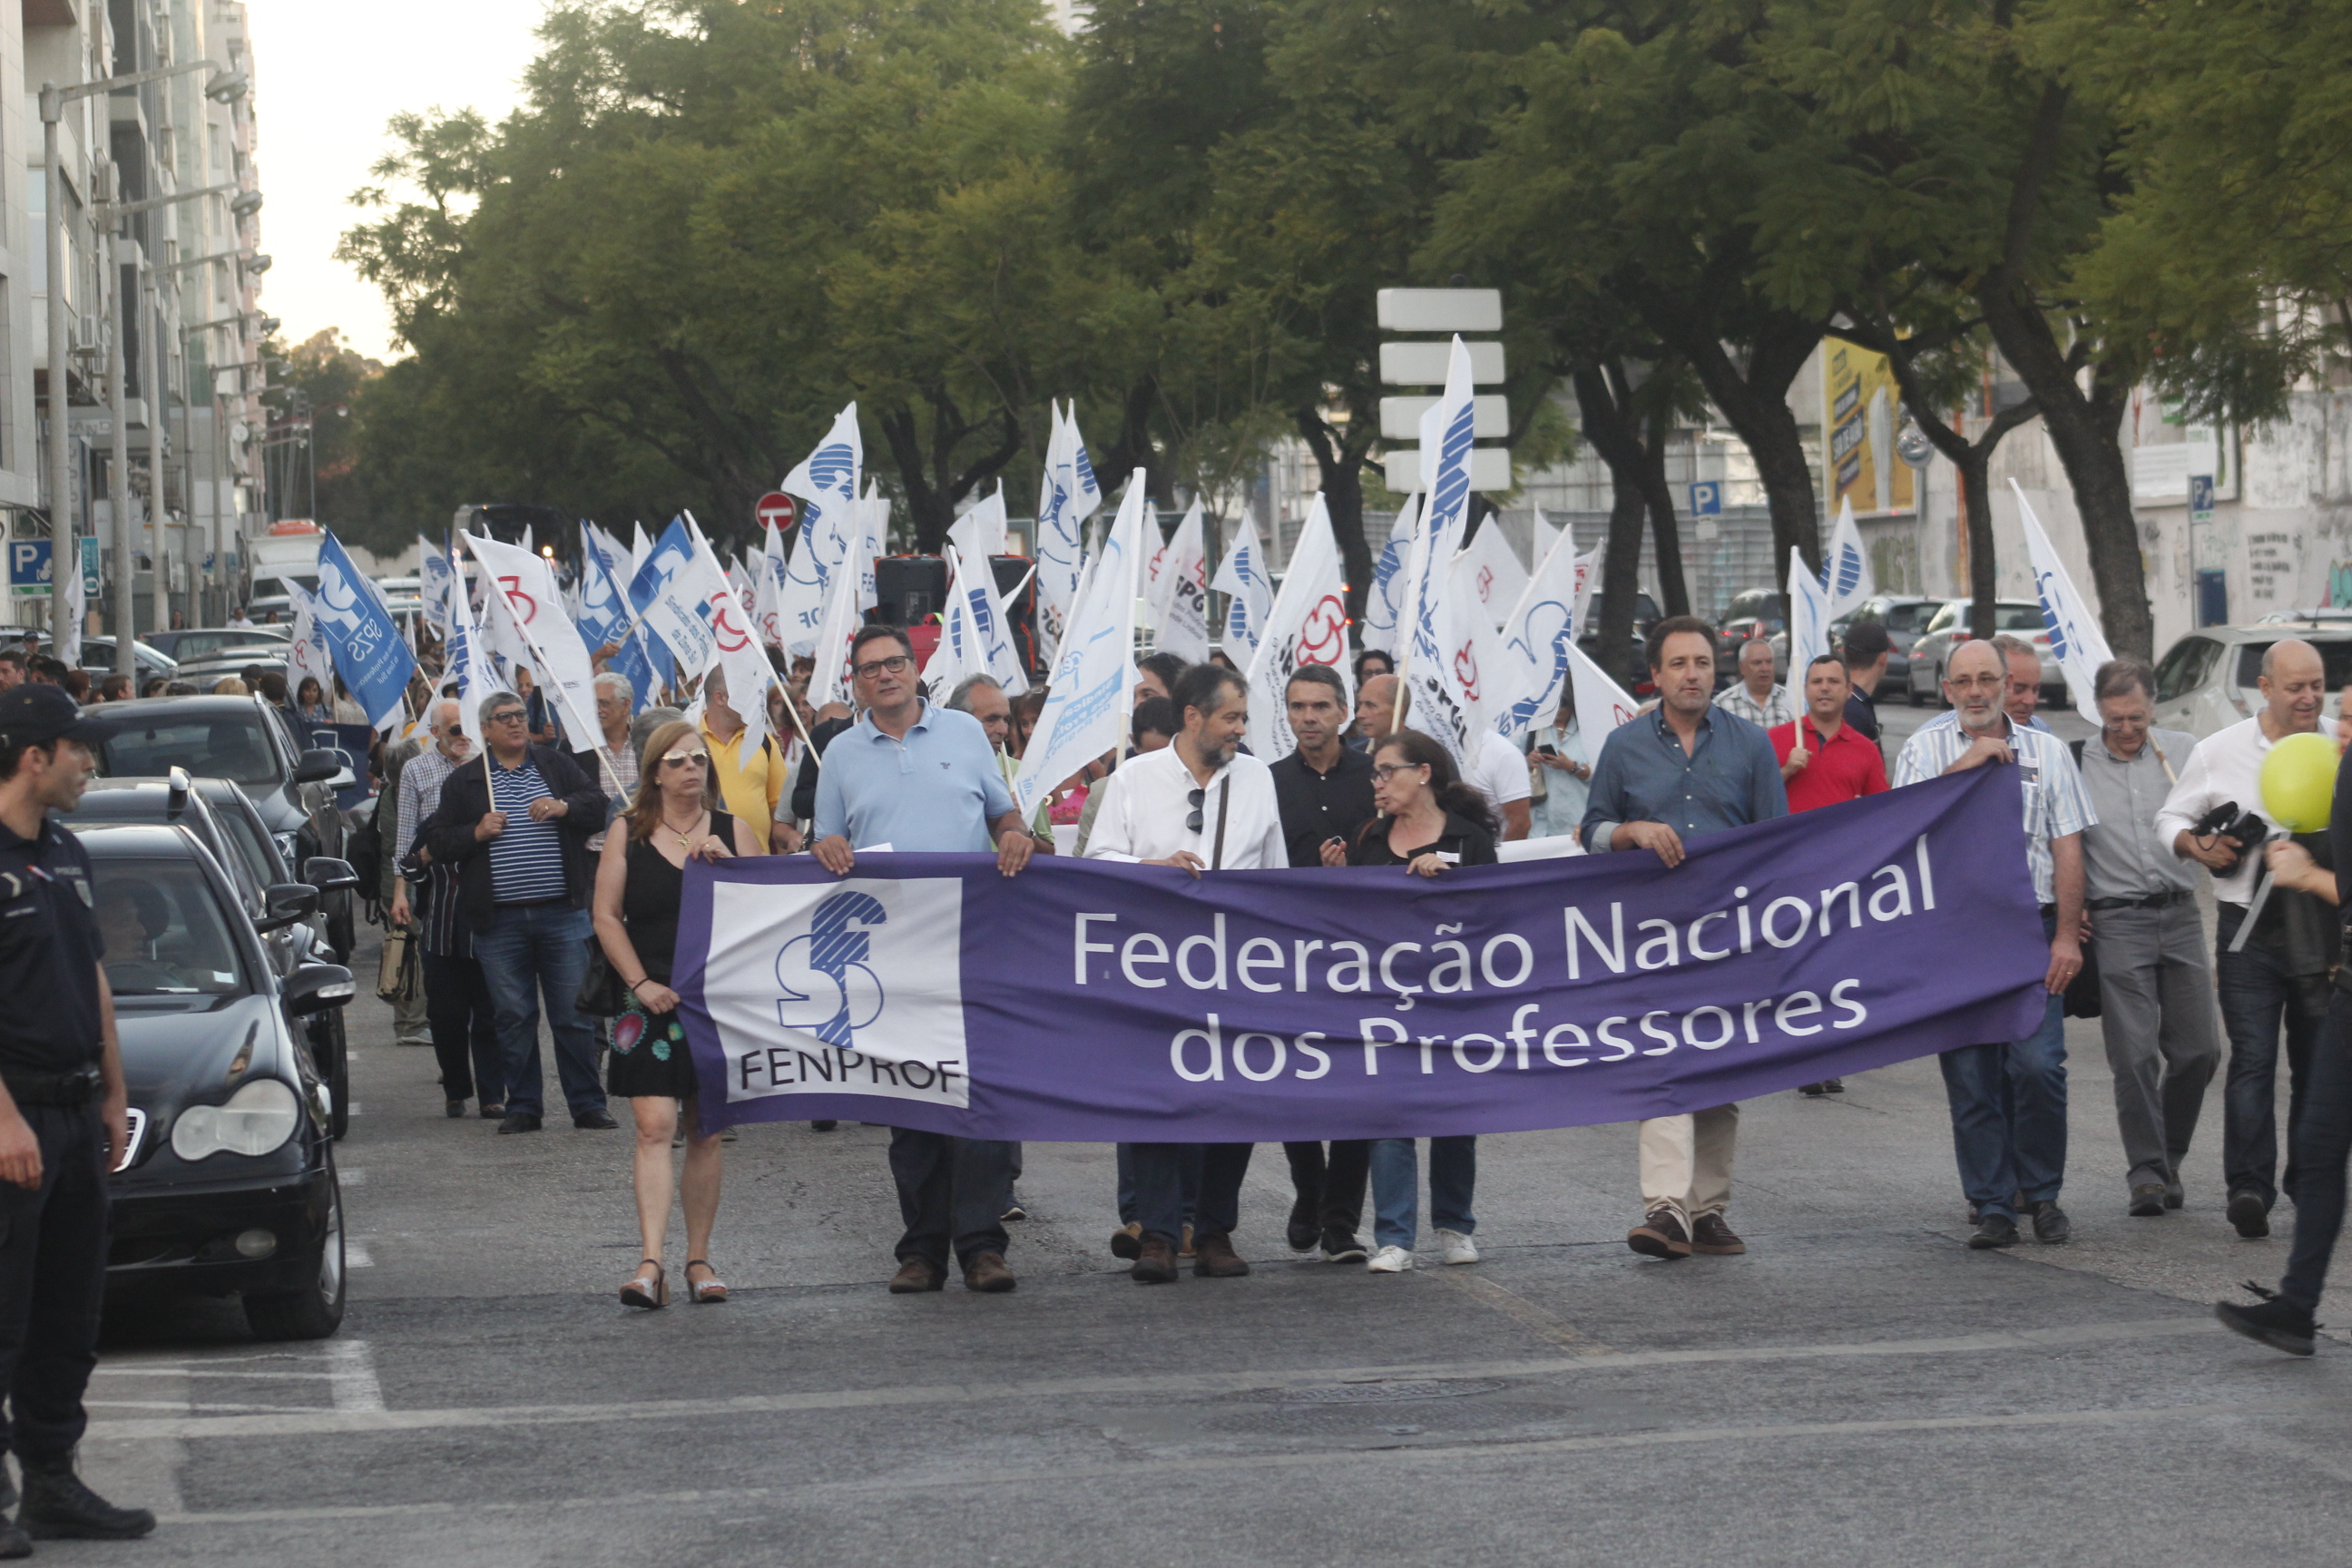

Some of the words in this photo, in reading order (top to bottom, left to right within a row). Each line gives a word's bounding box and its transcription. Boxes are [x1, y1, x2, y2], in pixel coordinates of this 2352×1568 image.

[1693, 485, 1714, 514] P
[2193, 480, 2204, 503] P
[15, 544, 38, 573] P
[1073, 911, 1534, 1012] Federação
[1563, 832, 1936, 980] Nacional
[1170, 1013, 1331, 1082] dos
[1358, 978, 1867, 1076] Professores
[740, 1046, 961, 1093] FENPROF
